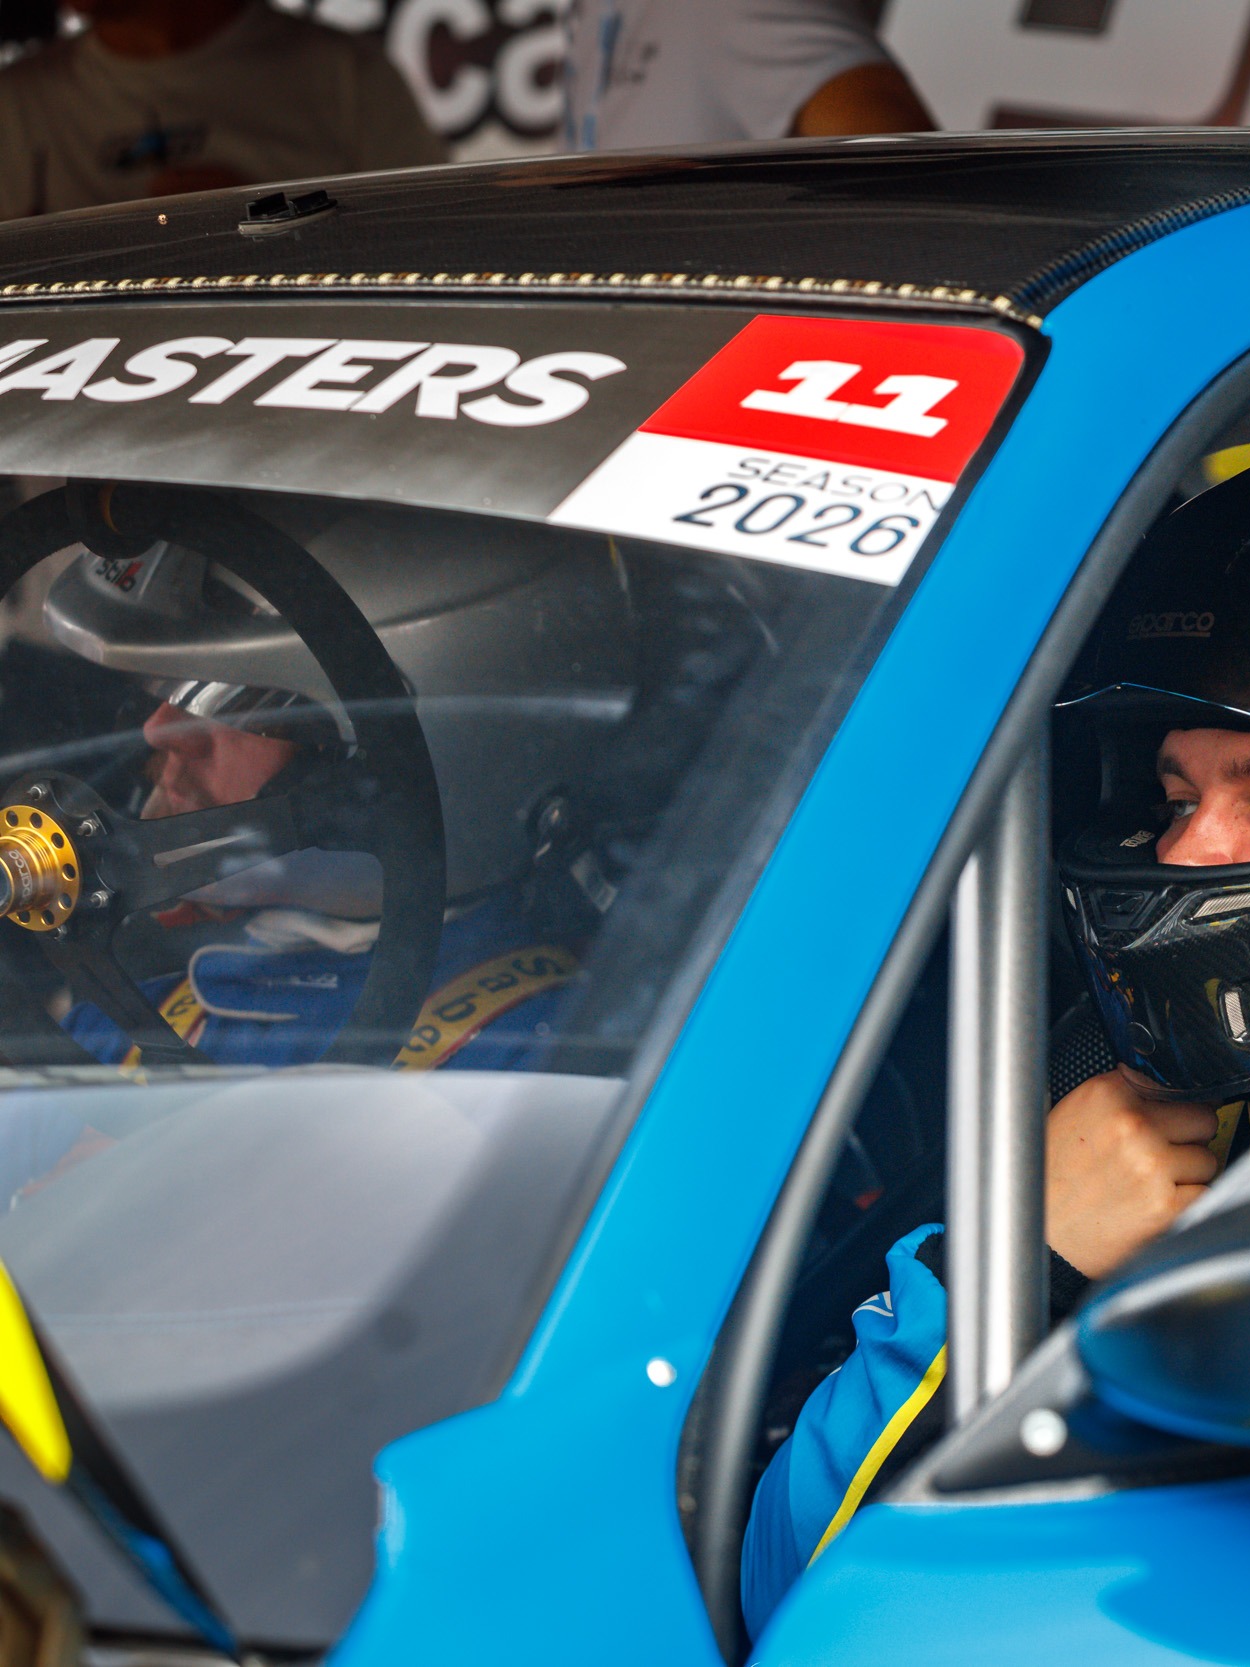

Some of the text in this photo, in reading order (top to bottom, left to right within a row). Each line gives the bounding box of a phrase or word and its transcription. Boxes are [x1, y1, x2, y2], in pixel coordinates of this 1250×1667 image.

[0, 336, 627, 427] ASTERS
[740, 360, 960, 438] 11
[672, 483, 920, 556] 2026
[726, 457, 942, 513] SEASON
